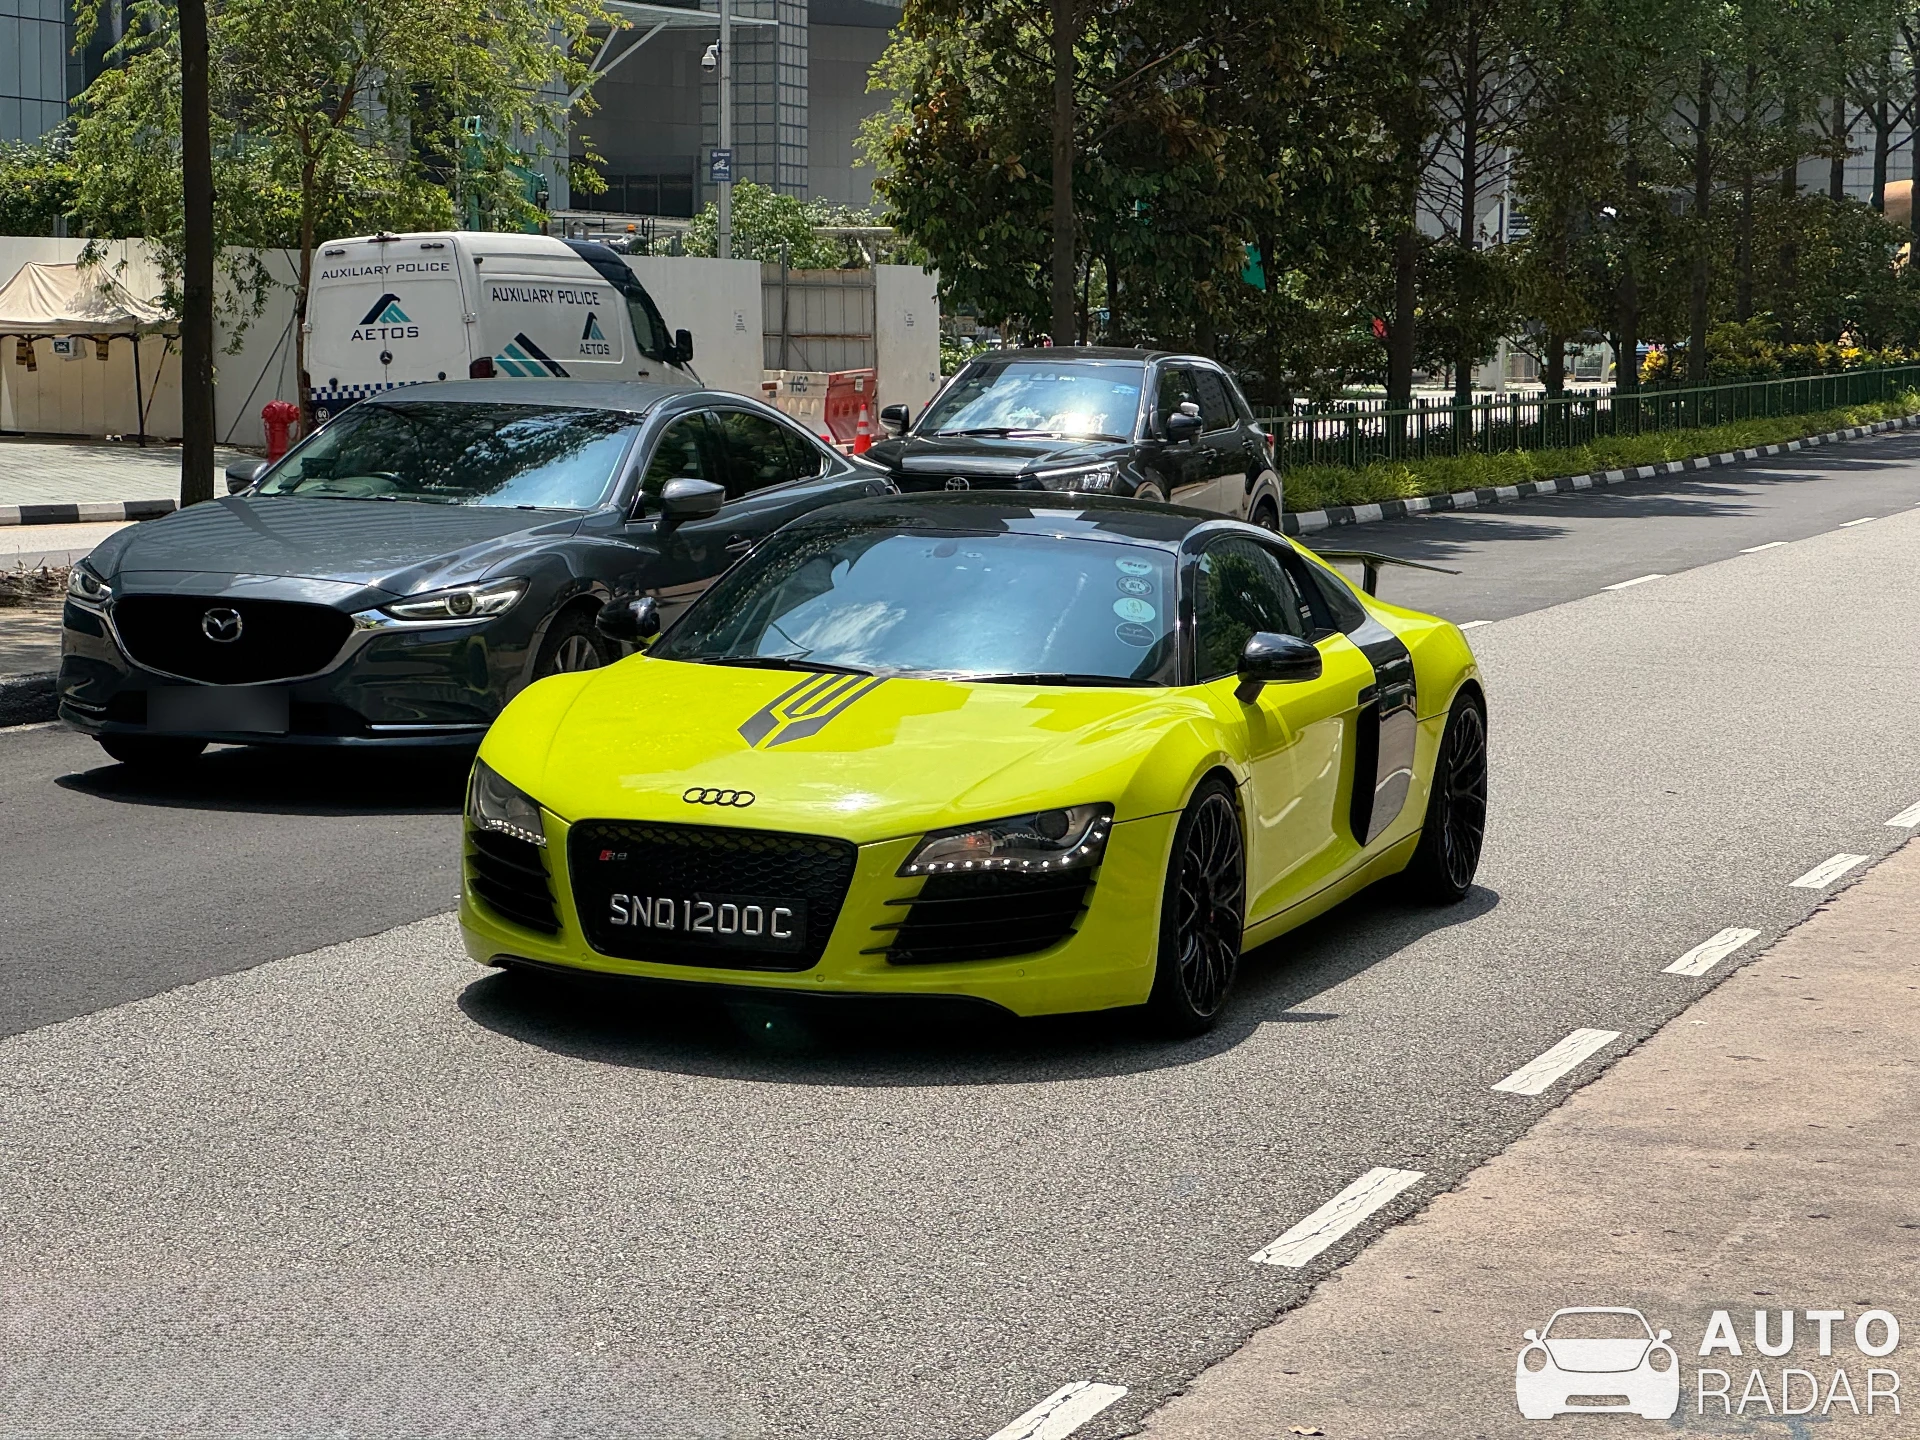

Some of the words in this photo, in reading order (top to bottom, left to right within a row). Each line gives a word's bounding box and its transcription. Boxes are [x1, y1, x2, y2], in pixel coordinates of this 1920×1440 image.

[321, 265, 392, 280] AUXILIARY
[396, 262, 450, 273] POLICE
[492, 287, 554, 303] AUXILIARY
[557, 290, 601, 306] POLICE
[351, 326, 419, 341] AETOS
[579, 343, 610, 355] AETOS
[609, 894, 792, 938] SNQ1200C
